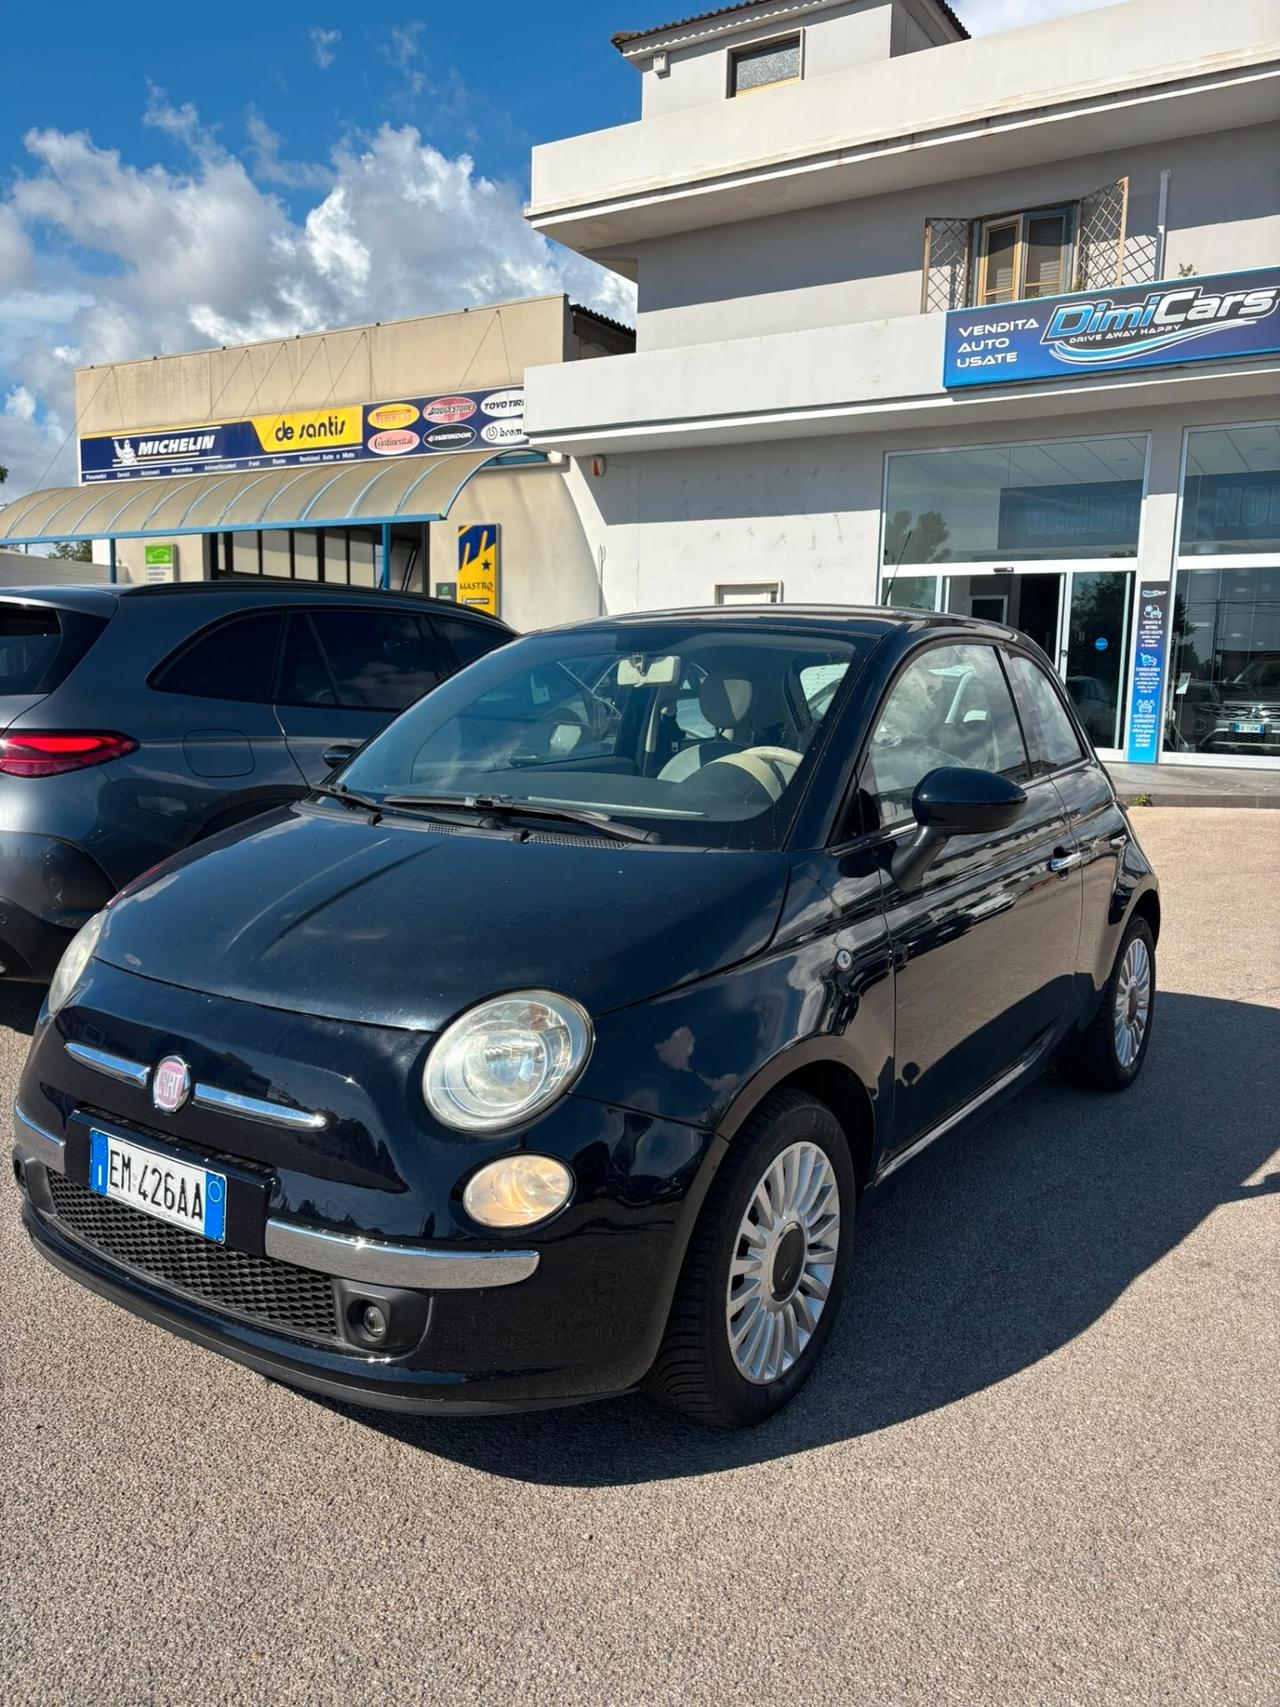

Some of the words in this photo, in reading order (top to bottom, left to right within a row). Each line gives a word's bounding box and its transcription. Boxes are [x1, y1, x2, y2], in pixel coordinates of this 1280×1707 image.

[1046, 288, 1279, 338] DimiCars
[958, 319, 1040, 338] VENDITA
[1069, 333, 1102, 345] DRIVE
[1105, 329, 1137, 340] AWAY
[1140, 324, 1181, 335] HAPPY
[958, 338, 1010, 353] AUTO
[957, 352, 1018, 368] USATE
[484, 401, 507, 410] TOYO
[275, 421, 294, 442] de
[299, 416, 346, 439] santis
[138, 435, 216, 455] MICHELIN
[374, 436, 413, 449] Continental
[109, 1149, 132, 1193] EM
[138, 1165, 204, 1221] 426AA
